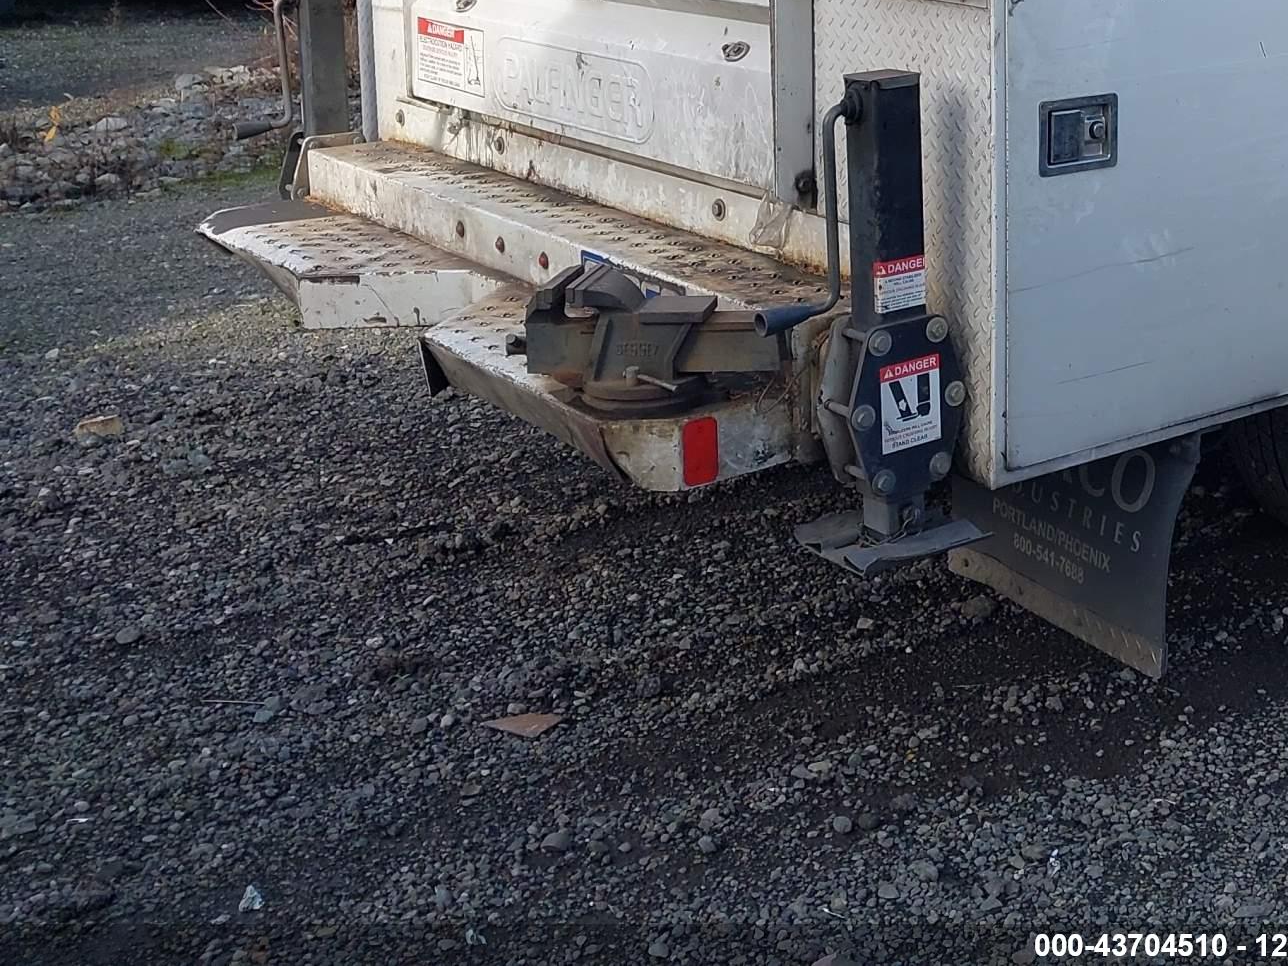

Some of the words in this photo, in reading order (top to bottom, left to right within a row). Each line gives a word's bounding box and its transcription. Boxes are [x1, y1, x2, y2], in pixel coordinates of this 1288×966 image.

[894, 357, 937, 376] DANGER
[993, 497, 1112, 573] PORTLAND/PHOENIX
[1012, 479, 1142, 552] DUSTRIES
